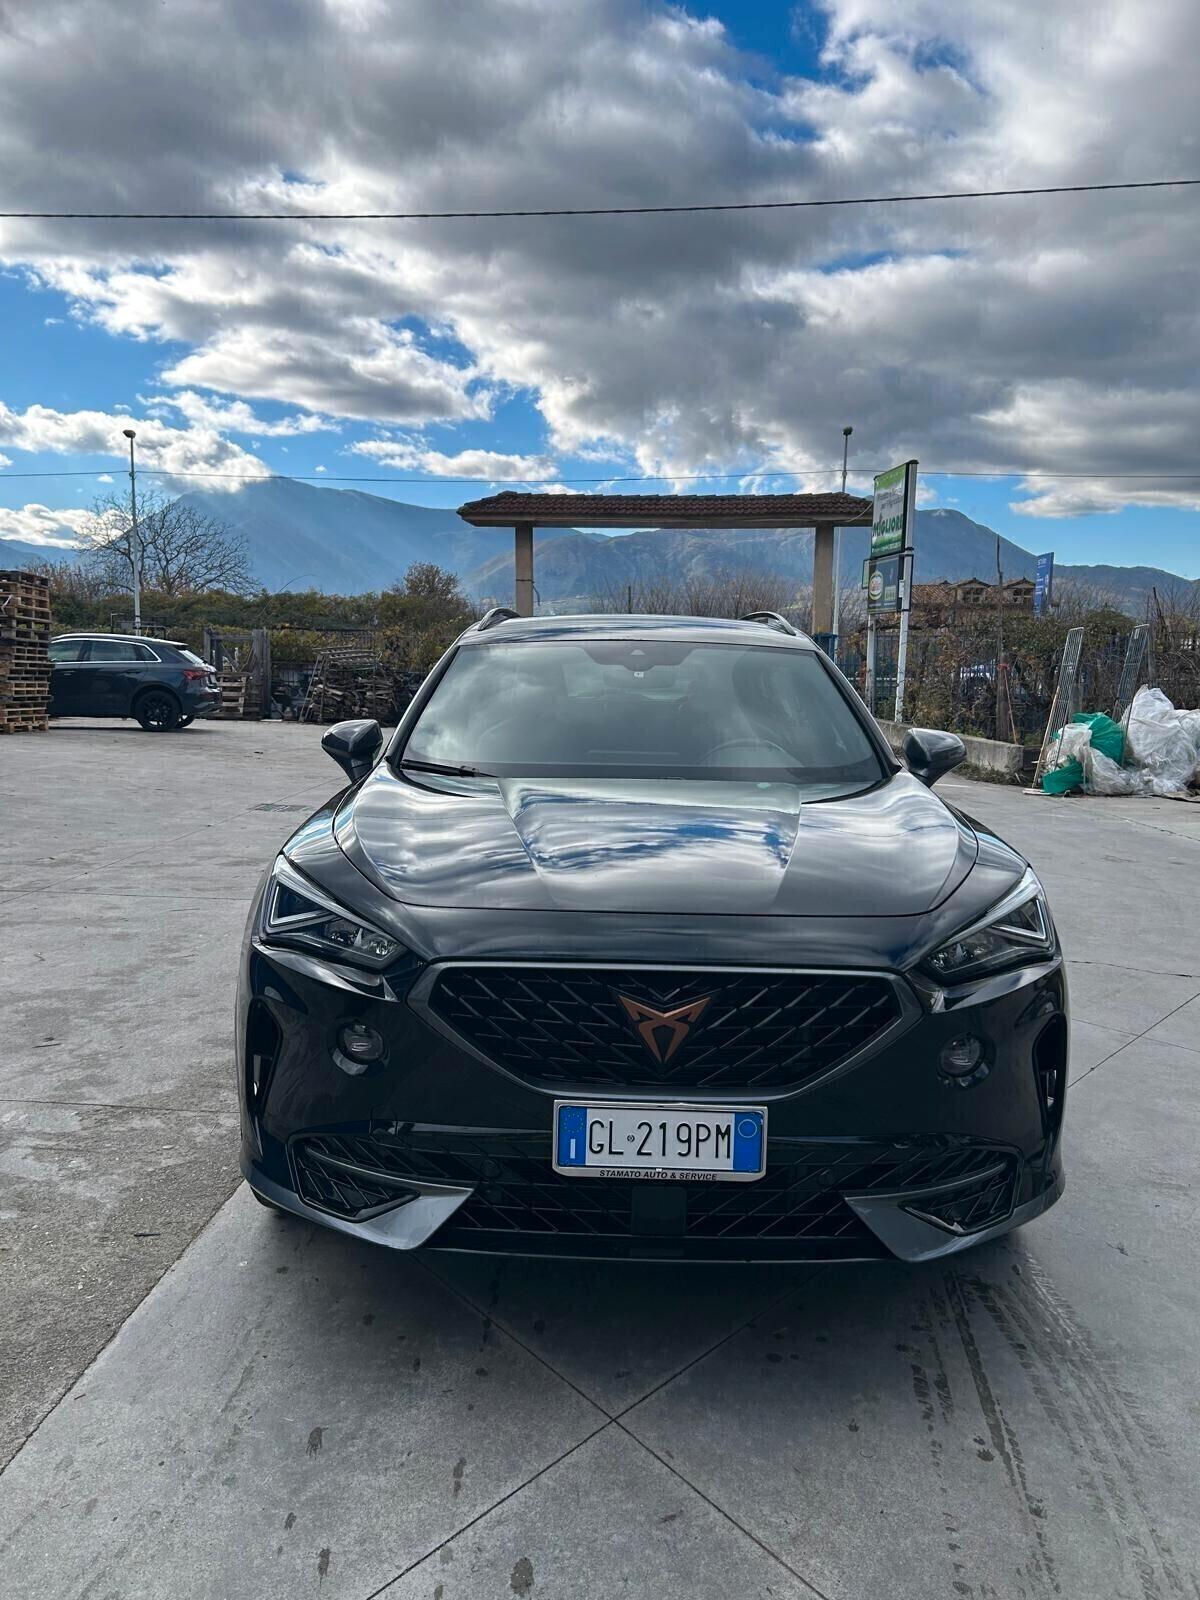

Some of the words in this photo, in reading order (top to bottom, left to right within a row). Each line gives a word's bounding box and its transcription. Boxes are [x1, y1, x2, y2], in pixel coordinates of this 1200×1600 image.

[599, 1169, 642, 1178] STAMATO
[643, 1170, 668, 1179] AUTO
[669, 1171, 677, 1179] &
[679, 1172, 718, 1181] SERVICE
